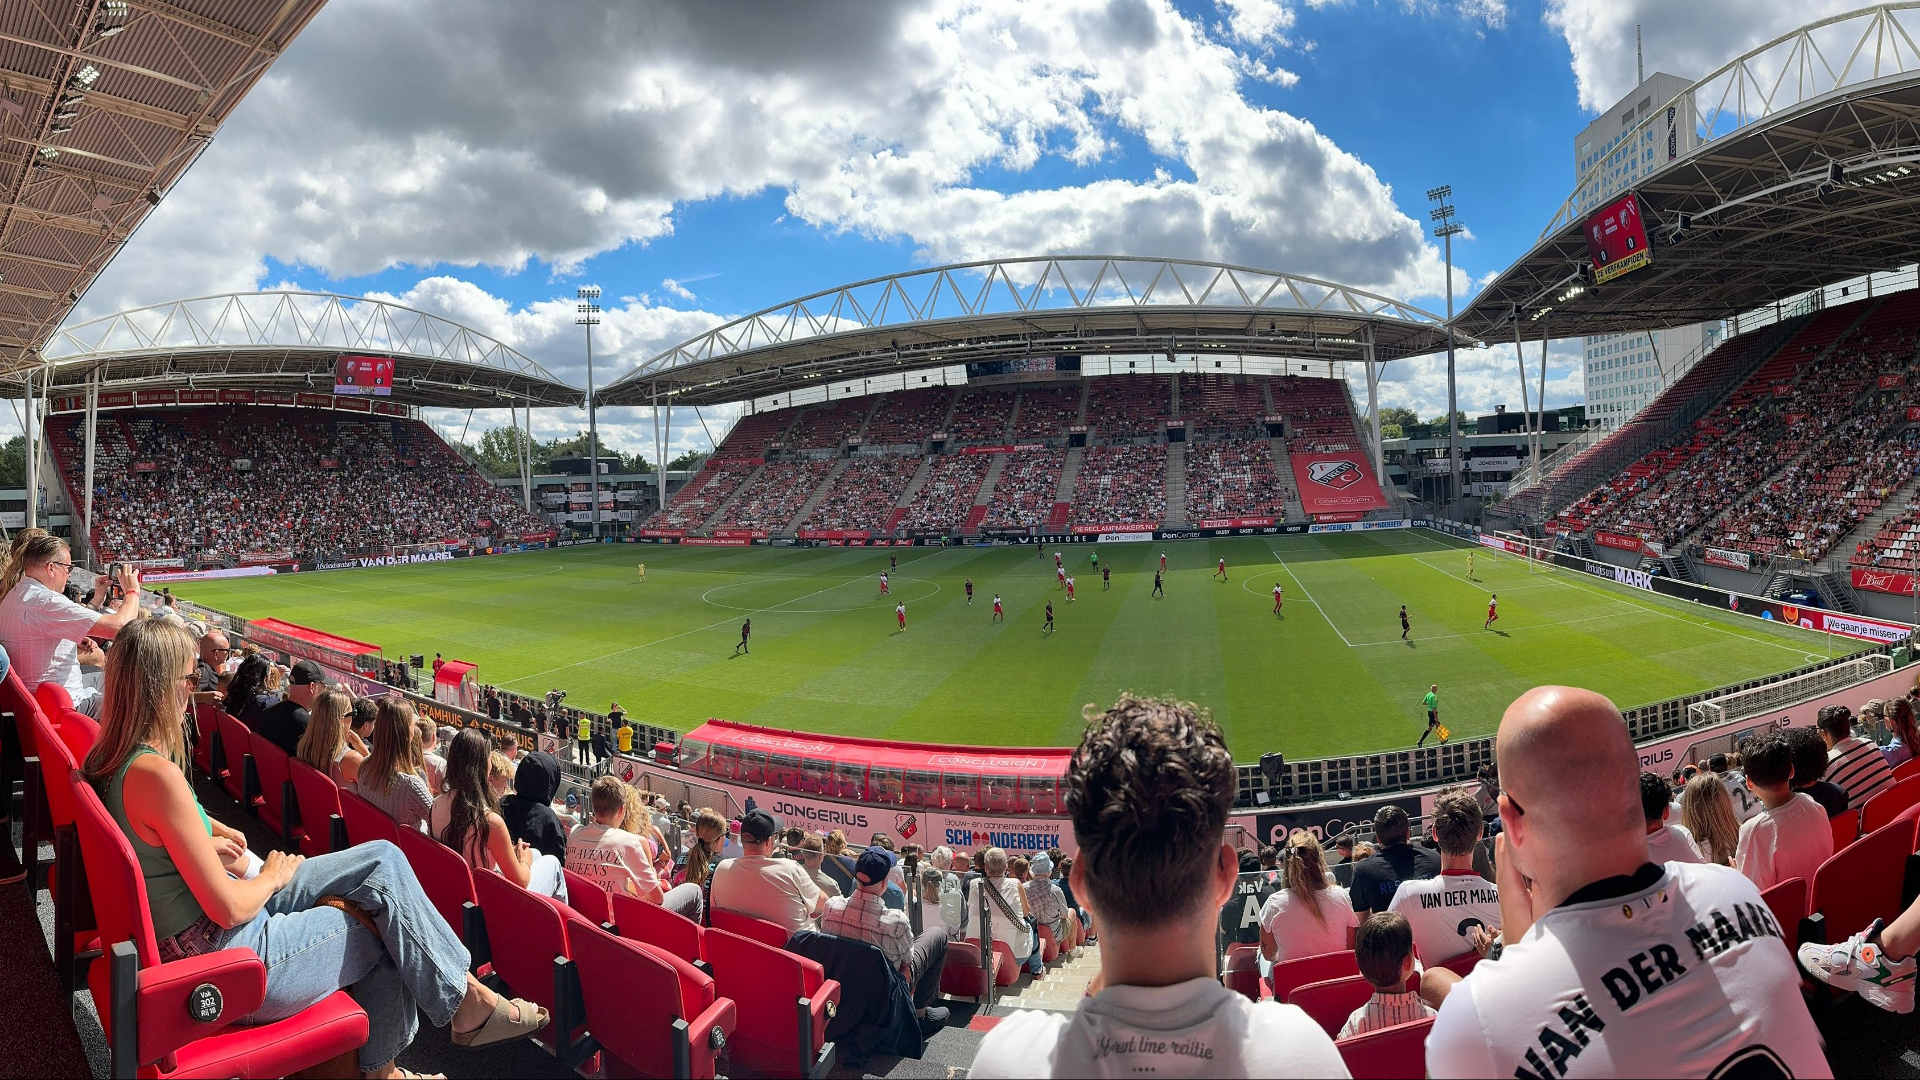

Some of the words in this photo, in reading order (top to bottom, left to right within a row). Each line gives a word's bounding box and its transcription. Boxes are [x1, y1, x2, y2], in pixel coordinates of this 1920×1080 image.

[1320, 461, 1355, 485] UTRECHT
[1318, 497, 1371, 505] CONCLUSION
[1033, 535, 1087, 543] CASTORE
[360, 556, 385, 568] VAN
[386, 554, 410, 566] DER
[411, 551, 455, 563] MAAREL
[1615, 566, 1653, 591] MARK
[1828, 618, 1840, 628] We
[1840, 623, 1860, 635] gaan
[1869, 627, 1898, 640] missen
[419, 703, 463, 728] STAMHUIS
[740, 736, 825, 752] CONCLUSION
[938, 757, 1038, 767] CONCLUSION
[772, 801, 869, 828] JONGERIUS
[944, 818, 970, 828] Bouw-
[972, 821, 983, 829] en
[984, 821, 1060, 832] aannemingsbedrijf
[566, 861, 609, 877] QUEENS
[1420, 892, 1442, 909] VAN
[1445, 890, 1468, 907] DER
[200, 990, 212, 999] Vak
[200, 997, 215, 1008] 302
[200, 1009, 210, 1017] Rij
[209, 1007, 217, 1015] 18
[1514, 994, 1606, 1080] VAN
[1600, 943, 1688, 1012] DER
